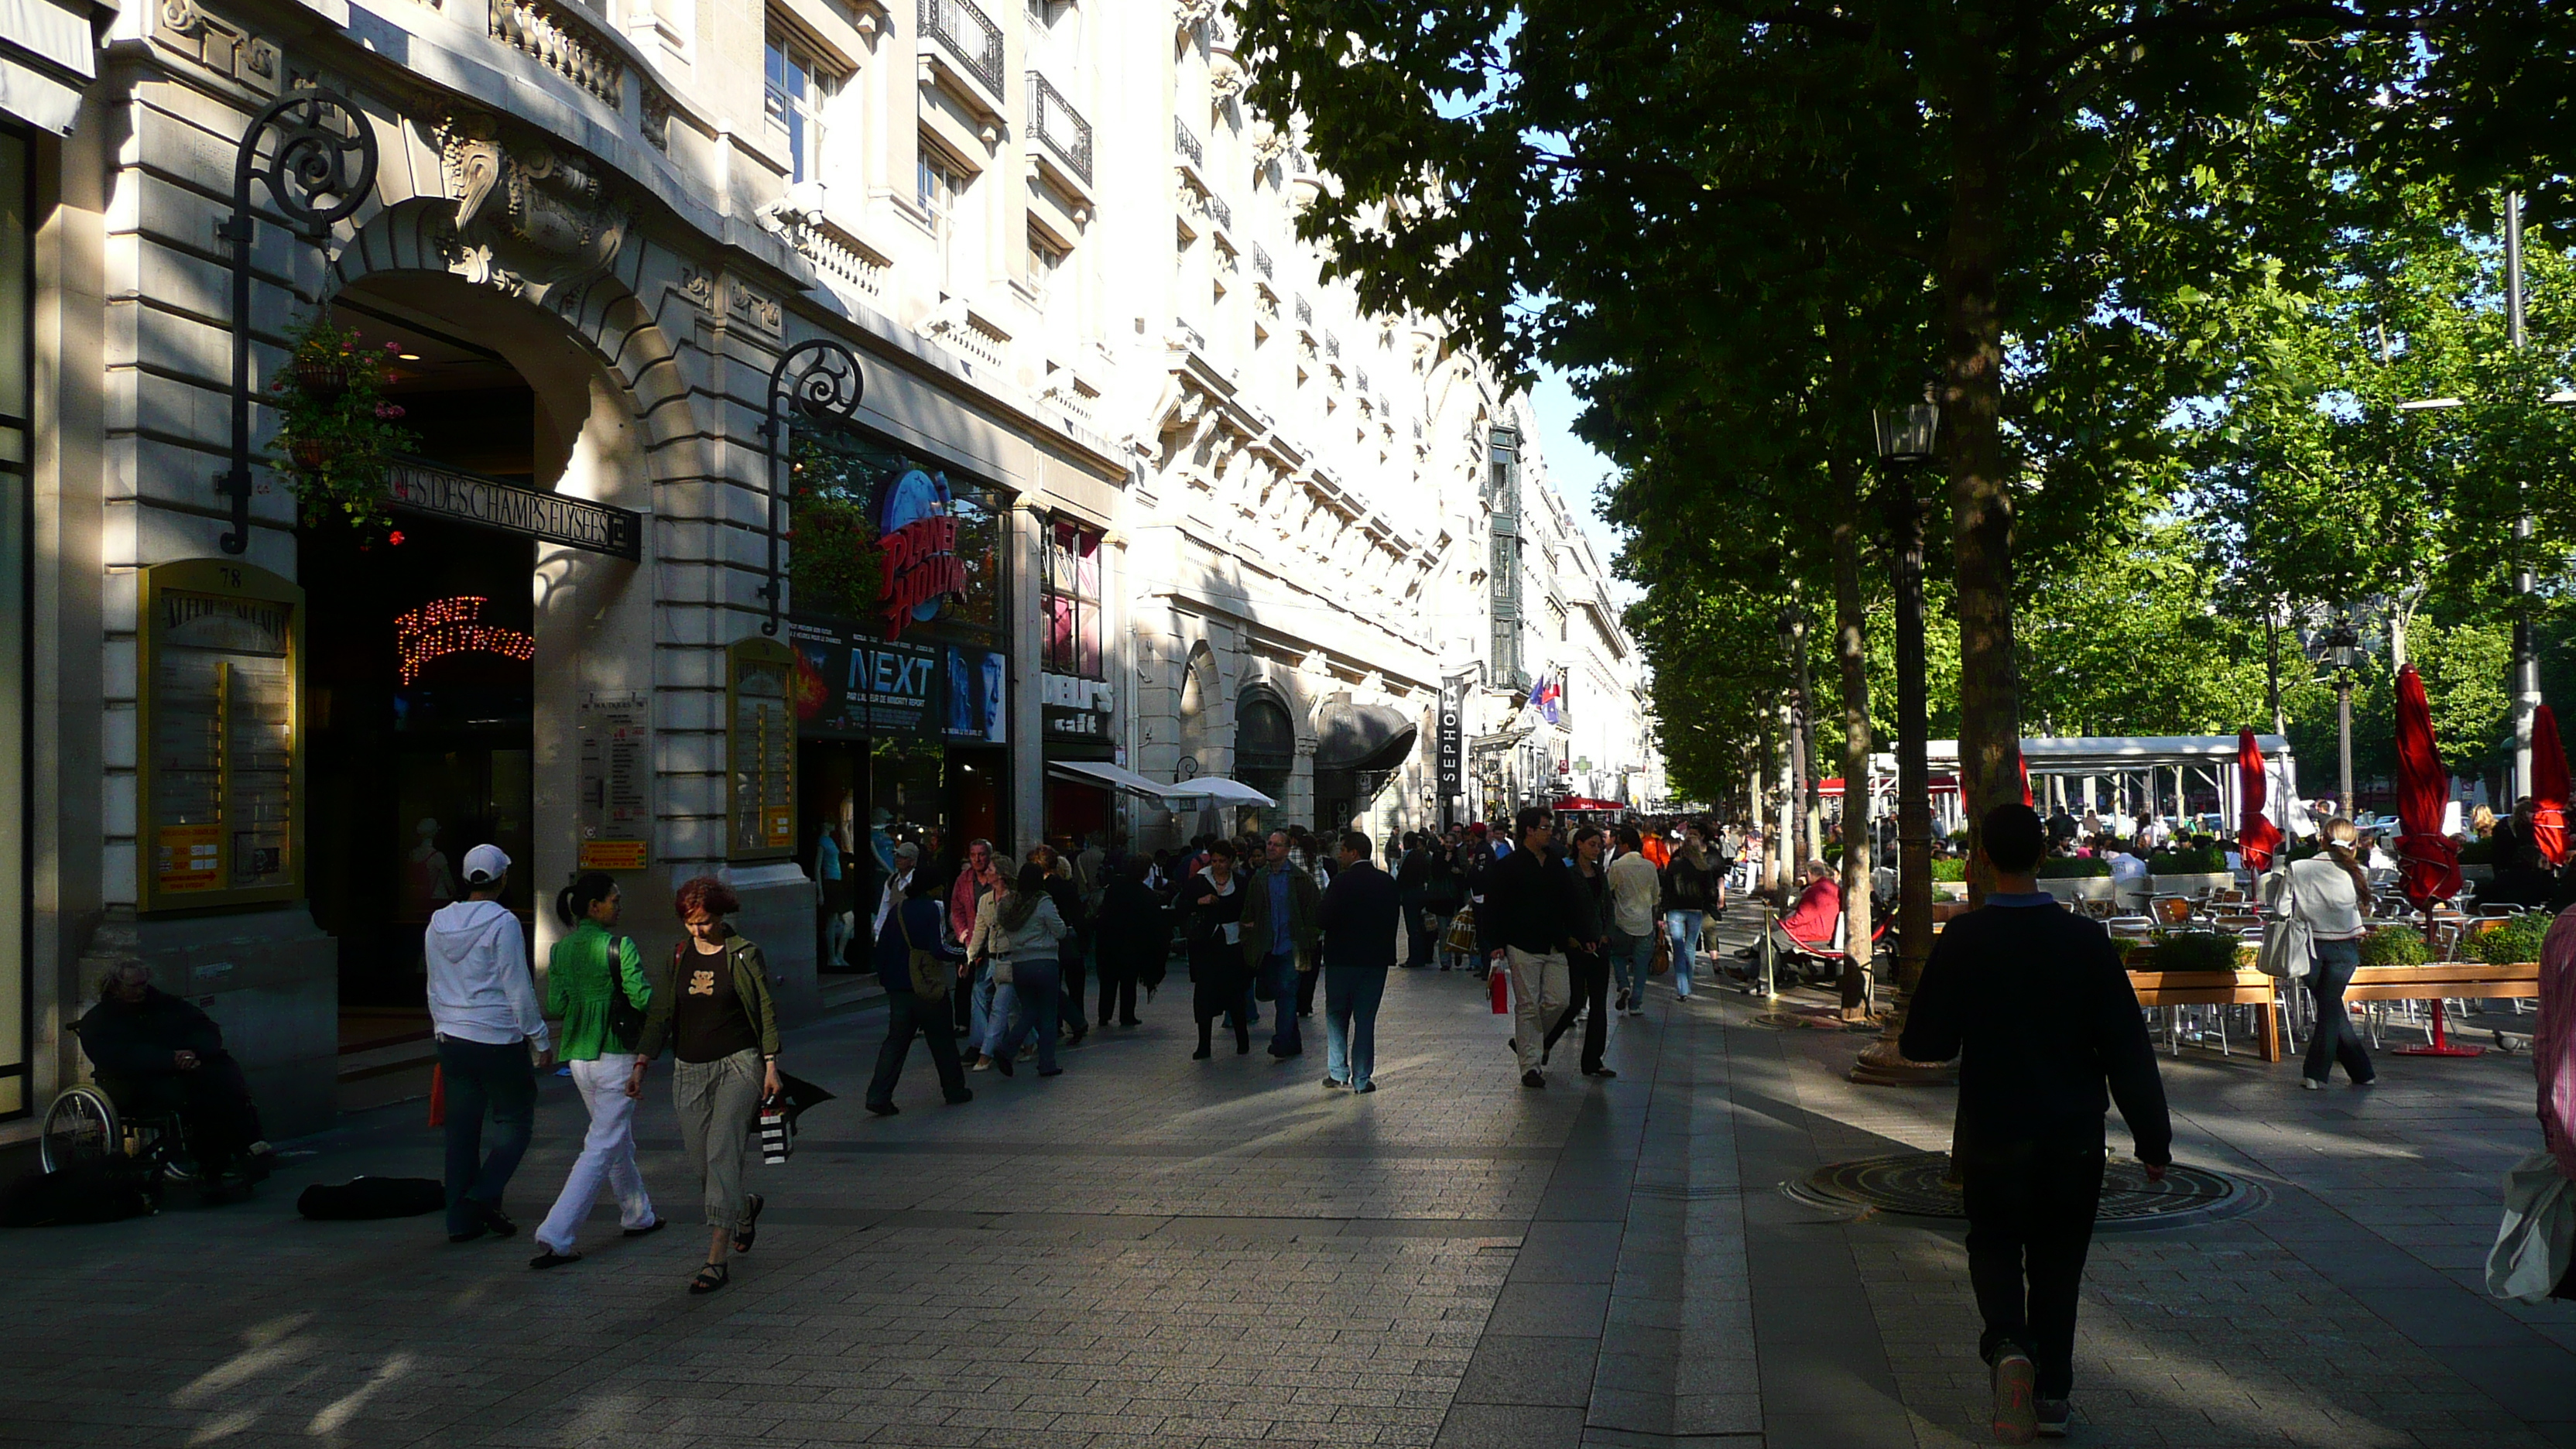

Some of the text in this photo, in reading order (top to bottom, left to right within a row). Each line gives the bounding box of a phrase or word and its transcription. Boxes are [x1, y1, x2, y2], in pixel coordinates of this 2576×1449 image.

[431, 473, 468, 514] DES
[471, 484, 545, 532] CHAMPS
[550, 503, 608, 543] ELYSEES
[220, 567, 242, 588] 78
[875, 516, 960, 601] PLANET
[394, 596, 488, 655] PLANET
[848, 647, 934, 697] NEXT
[1443, 684, 1458, 783] SEPHORA
